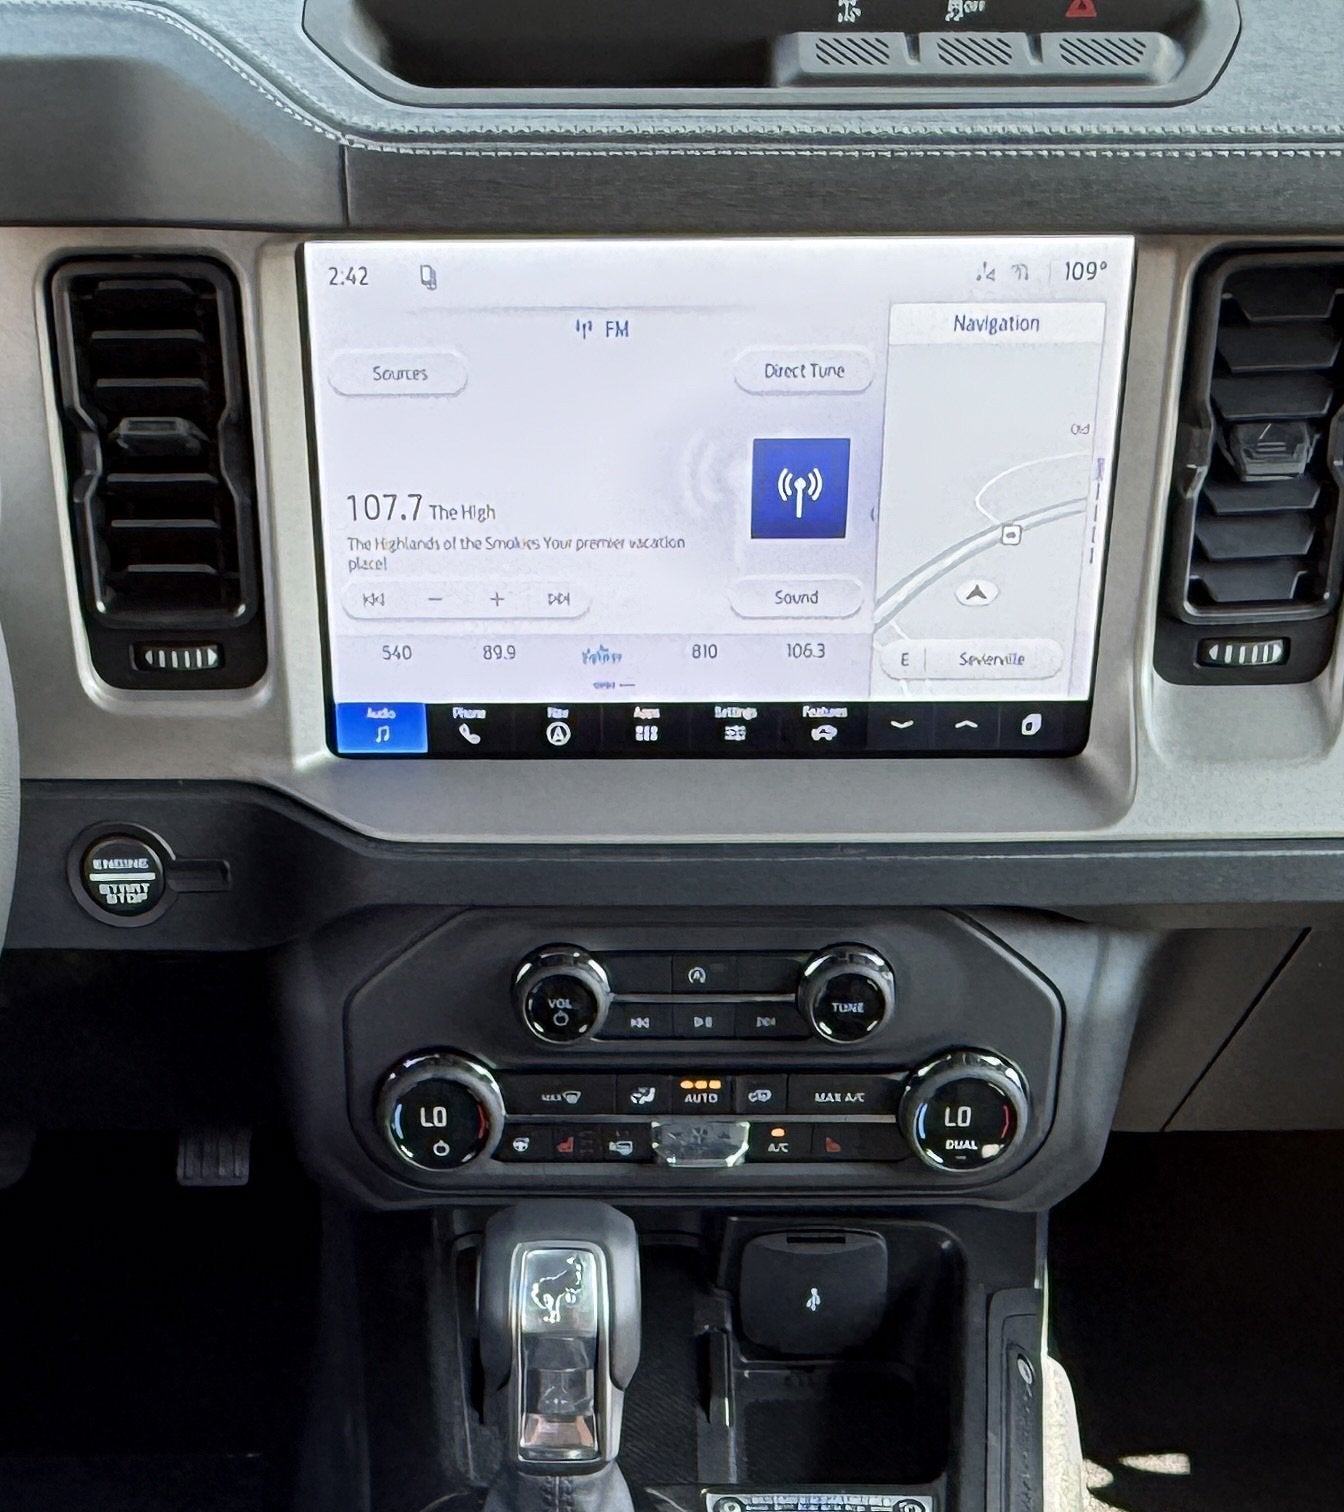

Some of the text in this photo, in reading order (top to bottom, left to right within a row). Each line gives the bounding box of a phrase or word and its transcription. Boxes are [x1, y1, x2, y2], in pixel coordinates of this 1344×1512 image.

[328, 266, 369, 286] 2:42
[605, 320, 630, 338] FM
[953, 314, 1041, 335] Navigation
[372, 365, 429, 382] Sources
[764, 363, 846, 379] Direct Tune
[347, 493, 497, 524] 107.7 The High
[347, 536, 686, 553] The Highlands of the Smokies Your premier vacation
[774, 589, 819, 605] Sound
[381, 645, 413, 660] 540
[482, 645, 517, 660] 89.9
[691, 643, 719, 660] 810
[786, 643, 826, 660] 106.3
[900, 653, 910, 667] E
[92, 858, 149, 870] ENGINE
[98, 883, 150, 895] START
[547, 998, 573, 1010] VOL
[831, 1002, 865, 1014] TUNE
[684, 1093, 719, 1104] AUTO
[420, 1106, 447, 1127] LO
[944, 1106, 972, 1127] LO
[767, 1142, 789, 1153] A/C
[945, 1139, 978, 1150] DUAL
